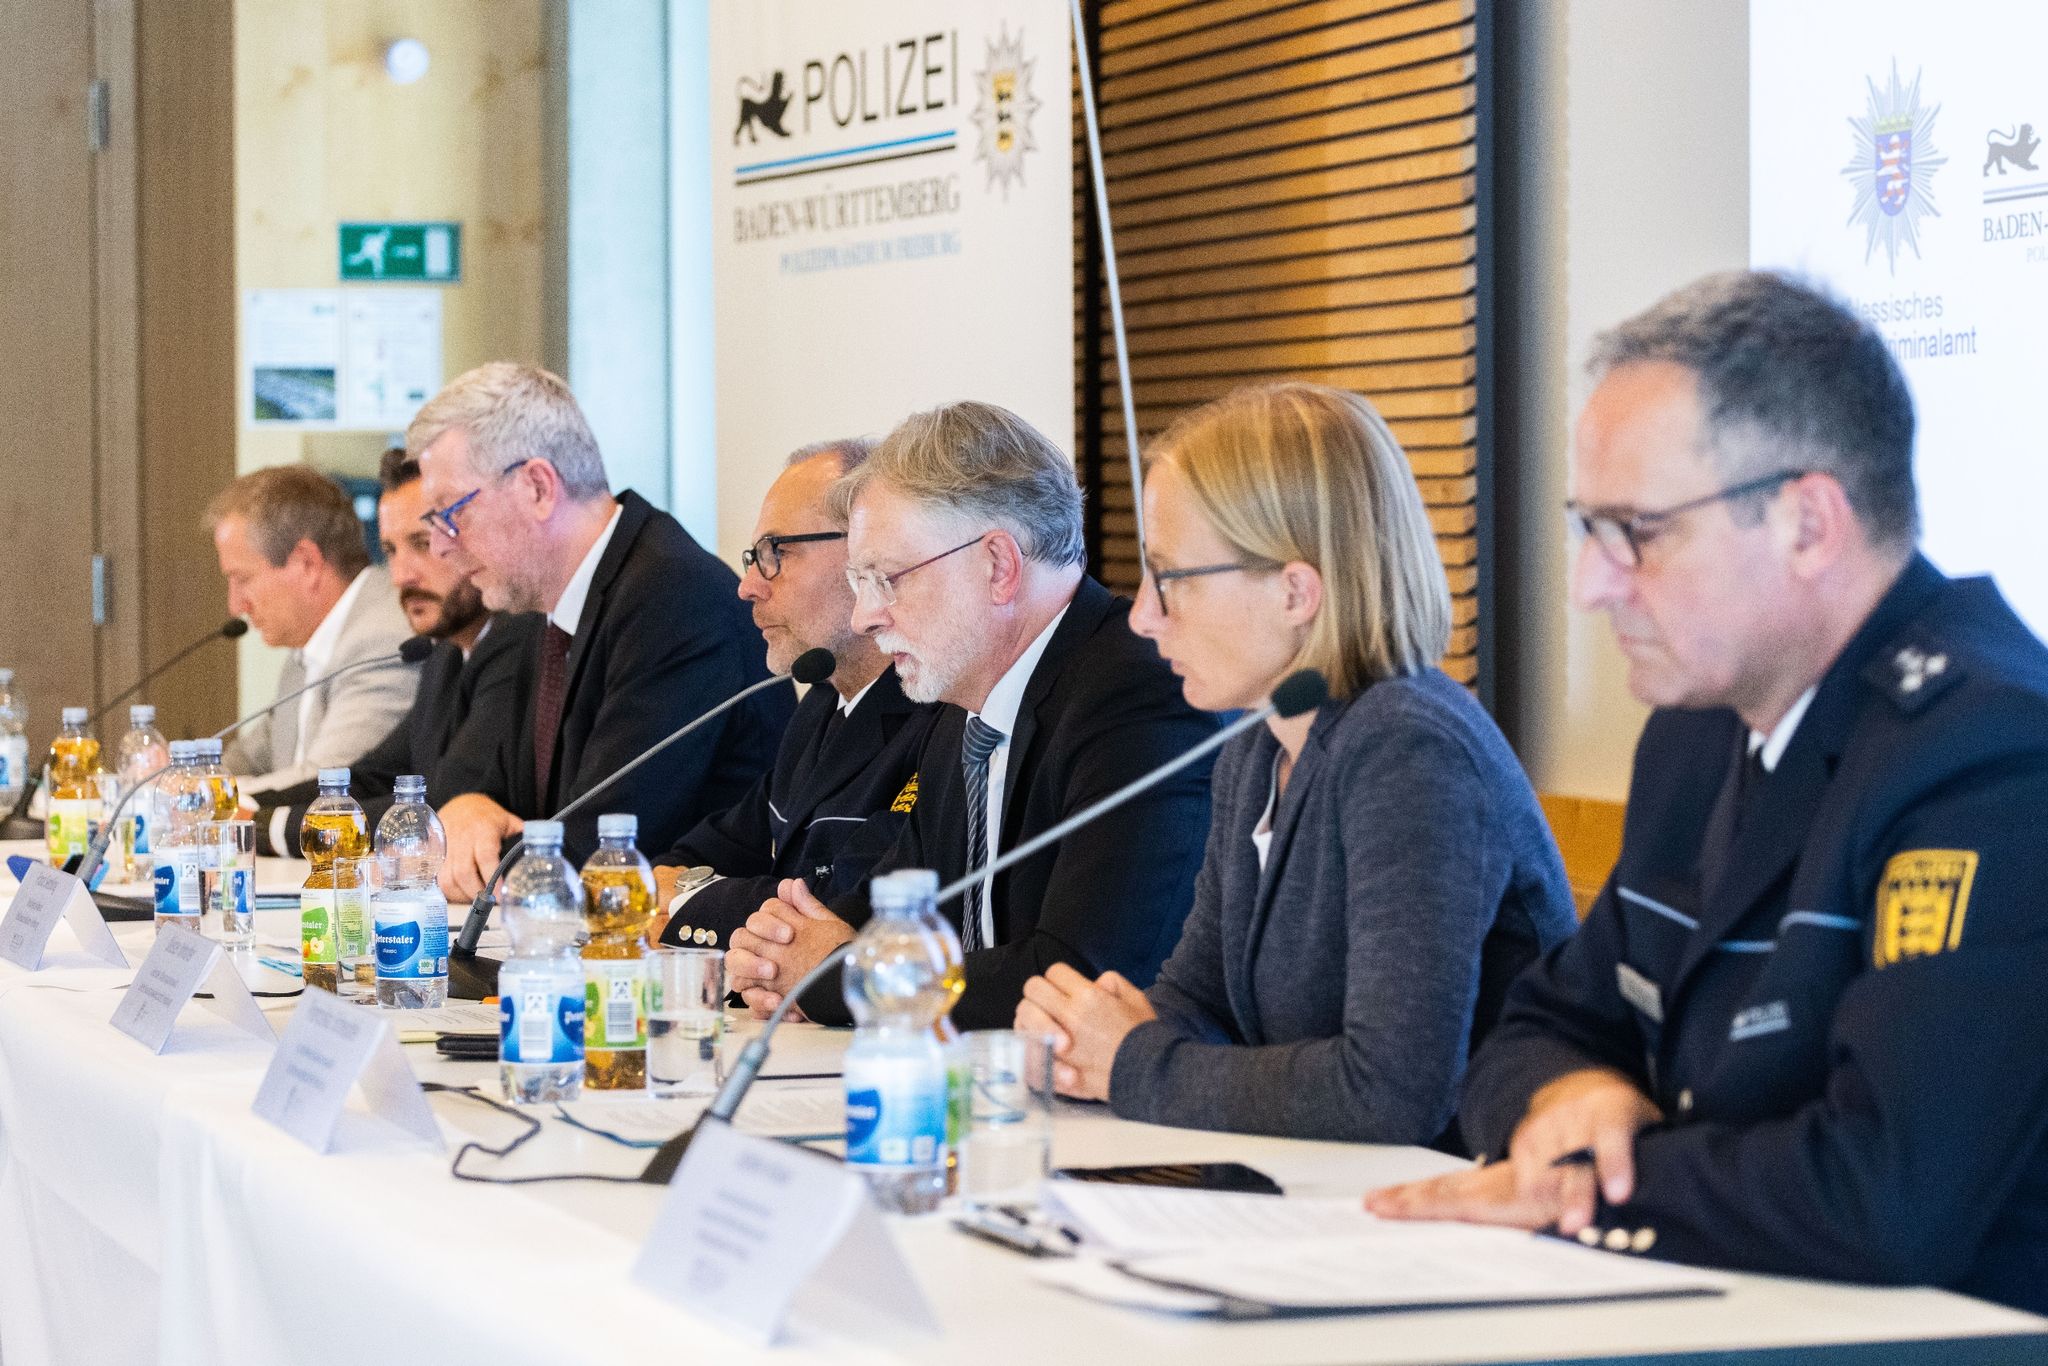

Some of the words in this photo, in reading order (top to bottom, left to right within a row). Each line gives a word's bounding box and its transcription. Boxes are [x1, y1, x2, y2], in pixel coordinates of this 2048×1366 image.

[803, 30, 958, 133] POLIZEI
[733, 174, 960, 244] BADEN-WÜRTTEMBERG
[1983, 210, 2048, 242] BADEN-
